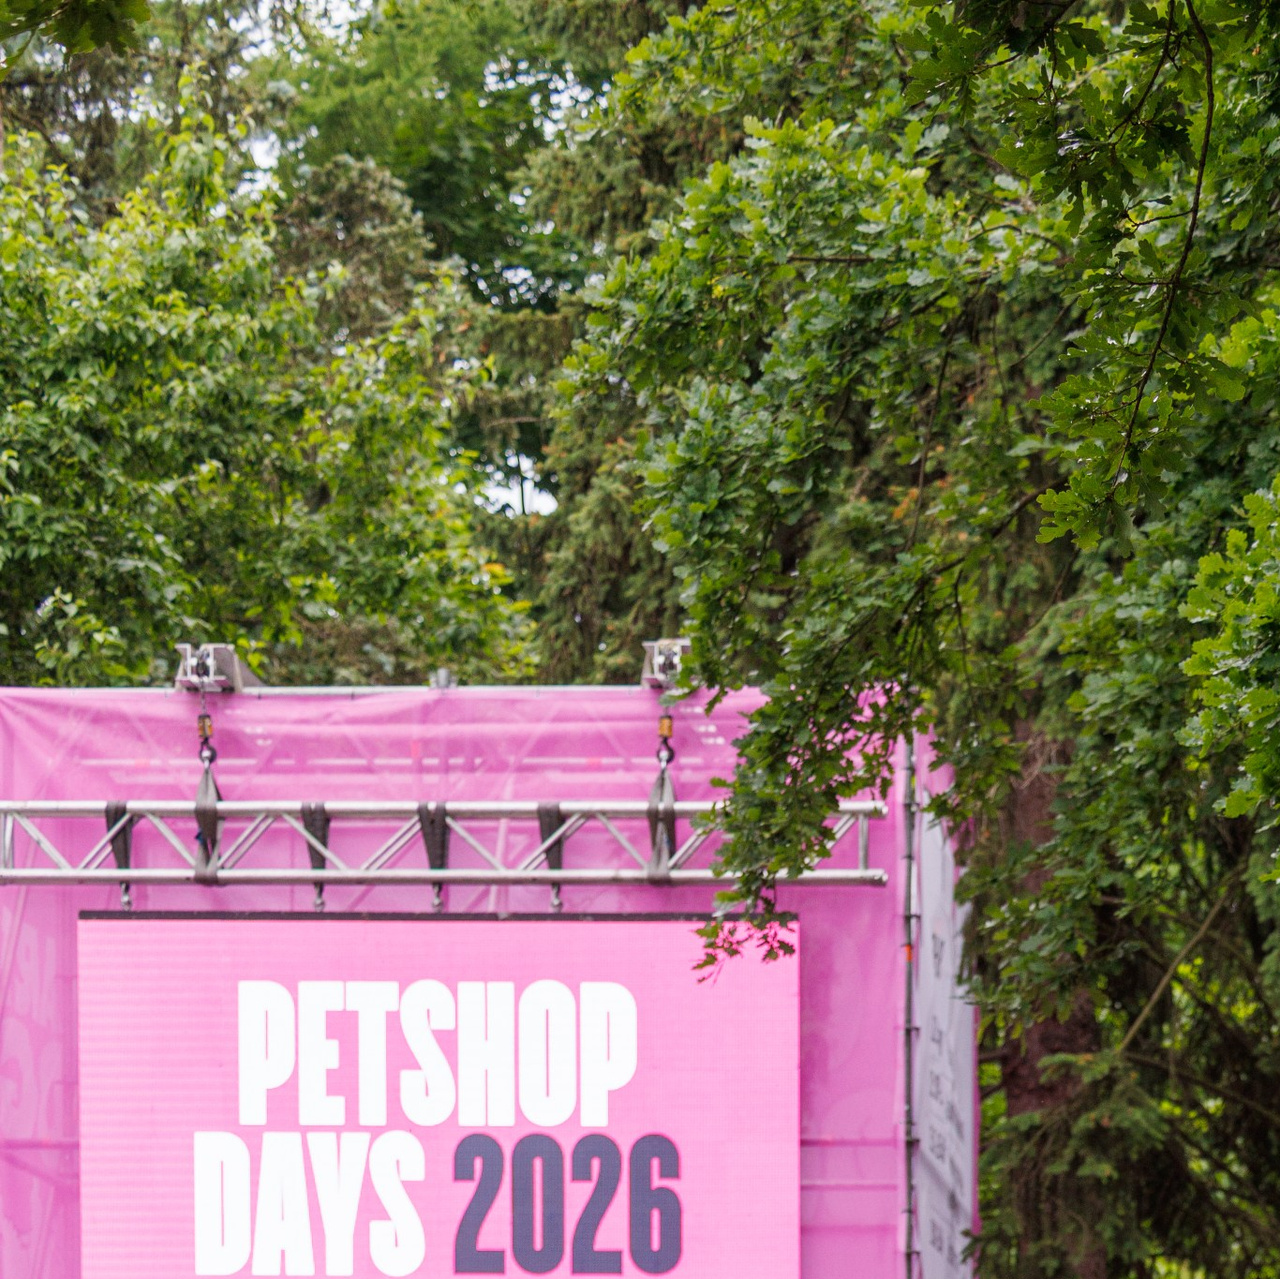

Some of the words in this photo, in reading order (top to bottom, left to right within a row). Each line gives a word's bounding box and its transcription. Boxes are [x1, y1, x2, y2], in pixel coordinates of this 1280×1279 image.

[238, 979, 638, 1127] PETSHOP
[193, 1130, 426, 1277] DAYS
[453, 1133, 683, 1275] 2026
